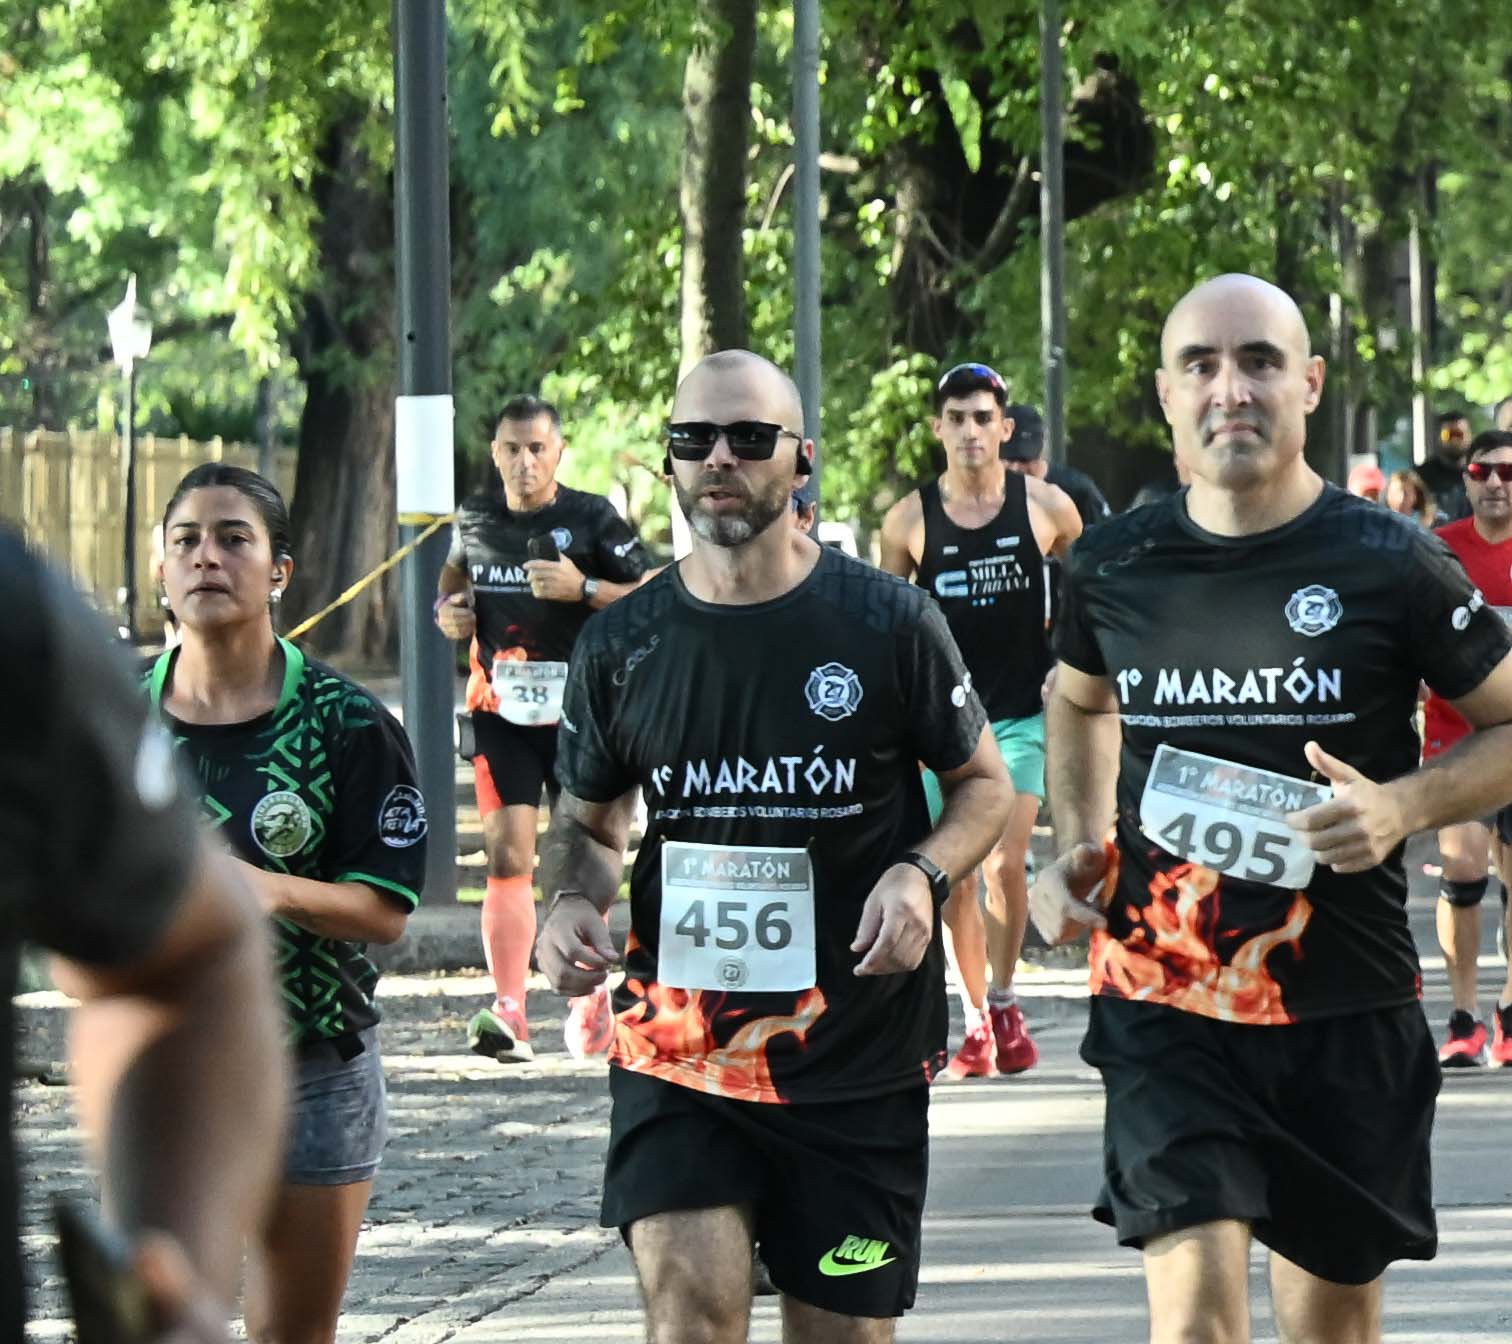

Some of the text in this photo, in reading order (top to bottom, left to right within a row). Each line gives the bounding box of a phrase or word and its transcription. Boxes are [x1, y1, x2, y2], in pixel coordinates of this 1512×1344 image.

[971, 563, 1023, 580] MILLA
[511, 685, 549, 705] 38
[823, 680, 845, 700] 27
[1115, 656, 1342, 706] 1° MARATÓN
[681, 744, 857, 798] MARATÓN
[1177, 765, 1199, 785] 1°
[1199, 770, 1304, 812] MARATÓN
[820, 803, 864, 819] ROSARIO
[1157, 812, 1292, 884] 495
[682, 856, 791, 879] 1° MARATÓN
[675, 899, 793, 951] 456
[835, 1234, 890, 1264] RUN
